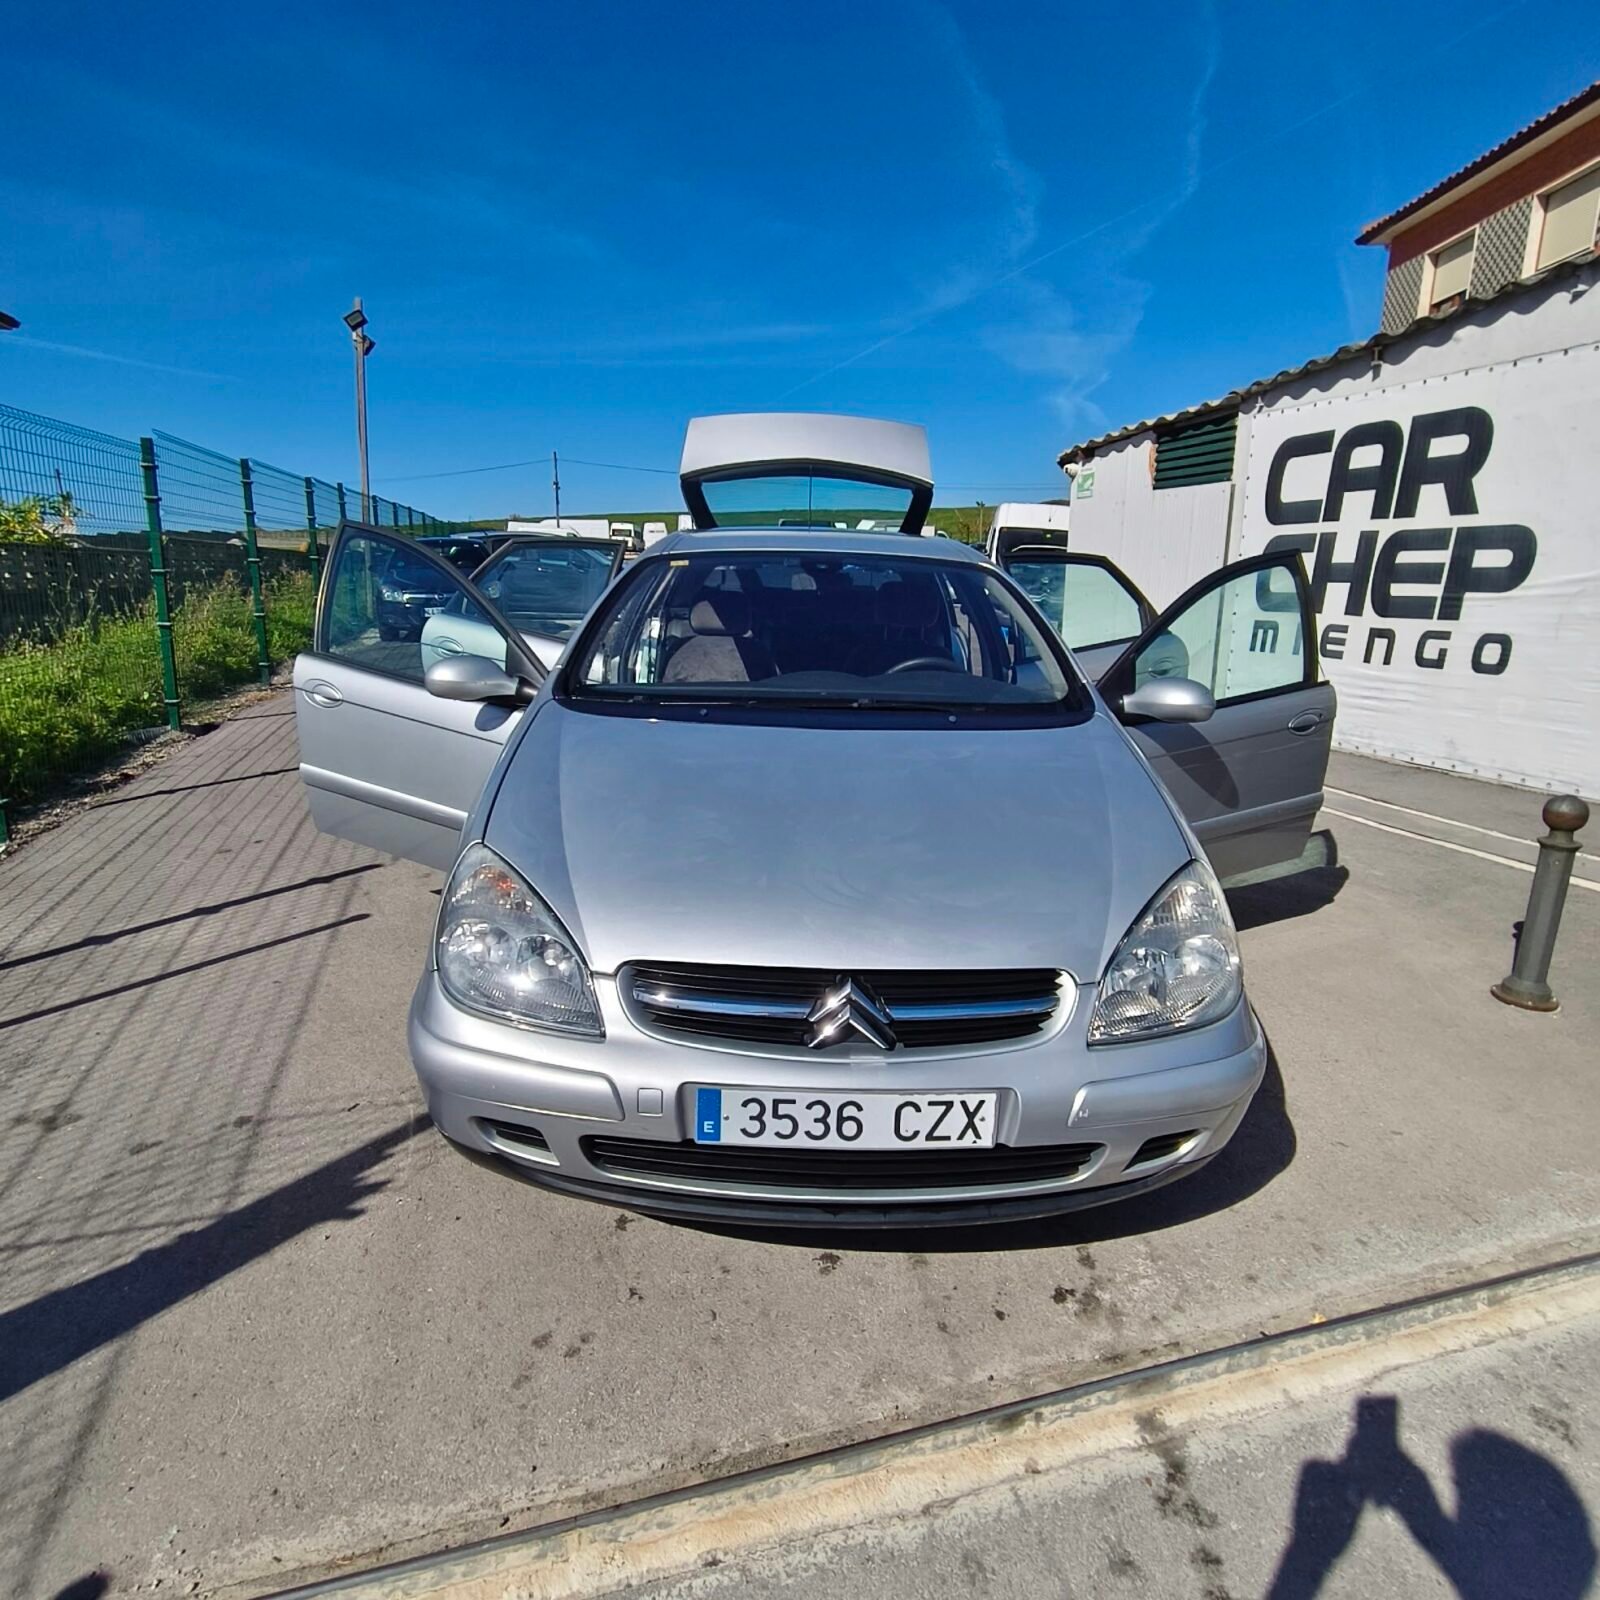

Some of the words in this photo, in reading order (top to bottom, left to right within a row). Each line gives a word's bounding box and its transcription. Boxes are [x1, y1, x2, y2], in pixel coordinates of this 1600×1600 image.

[1265, 406, 1494, 525] CAR
[1256, 524, 1538, 621] CHEP
[703, 1121, 715, 1133] E
[739, 1097, 864, 1142] 3536
[893, 1100, 987, 1142] CZX
